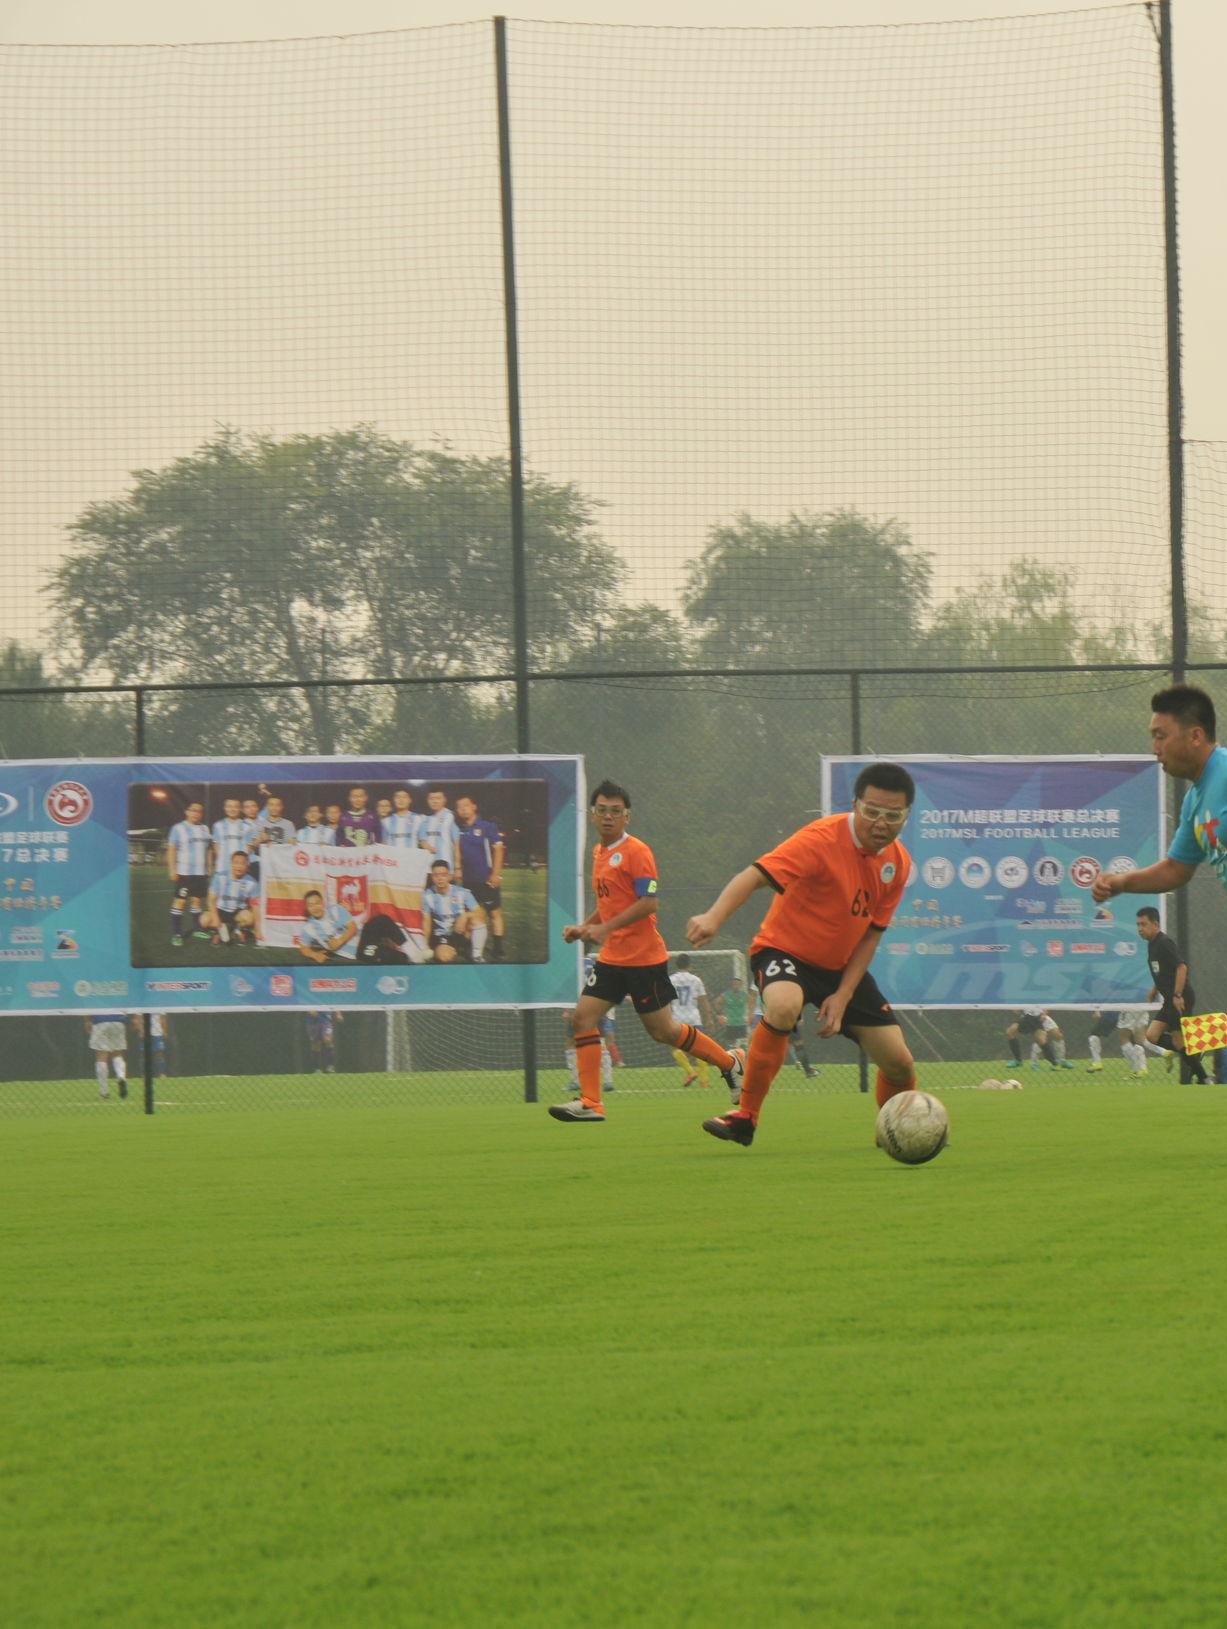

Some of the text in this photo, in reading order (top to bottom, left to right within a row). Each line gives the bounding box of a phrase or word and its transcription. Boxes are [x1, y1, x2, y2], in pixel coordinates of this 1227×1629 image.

[920, 827, 1121, 839] 2017MSL FOOTBALL LEAGUE
[765, 959, 797, 977] 62
